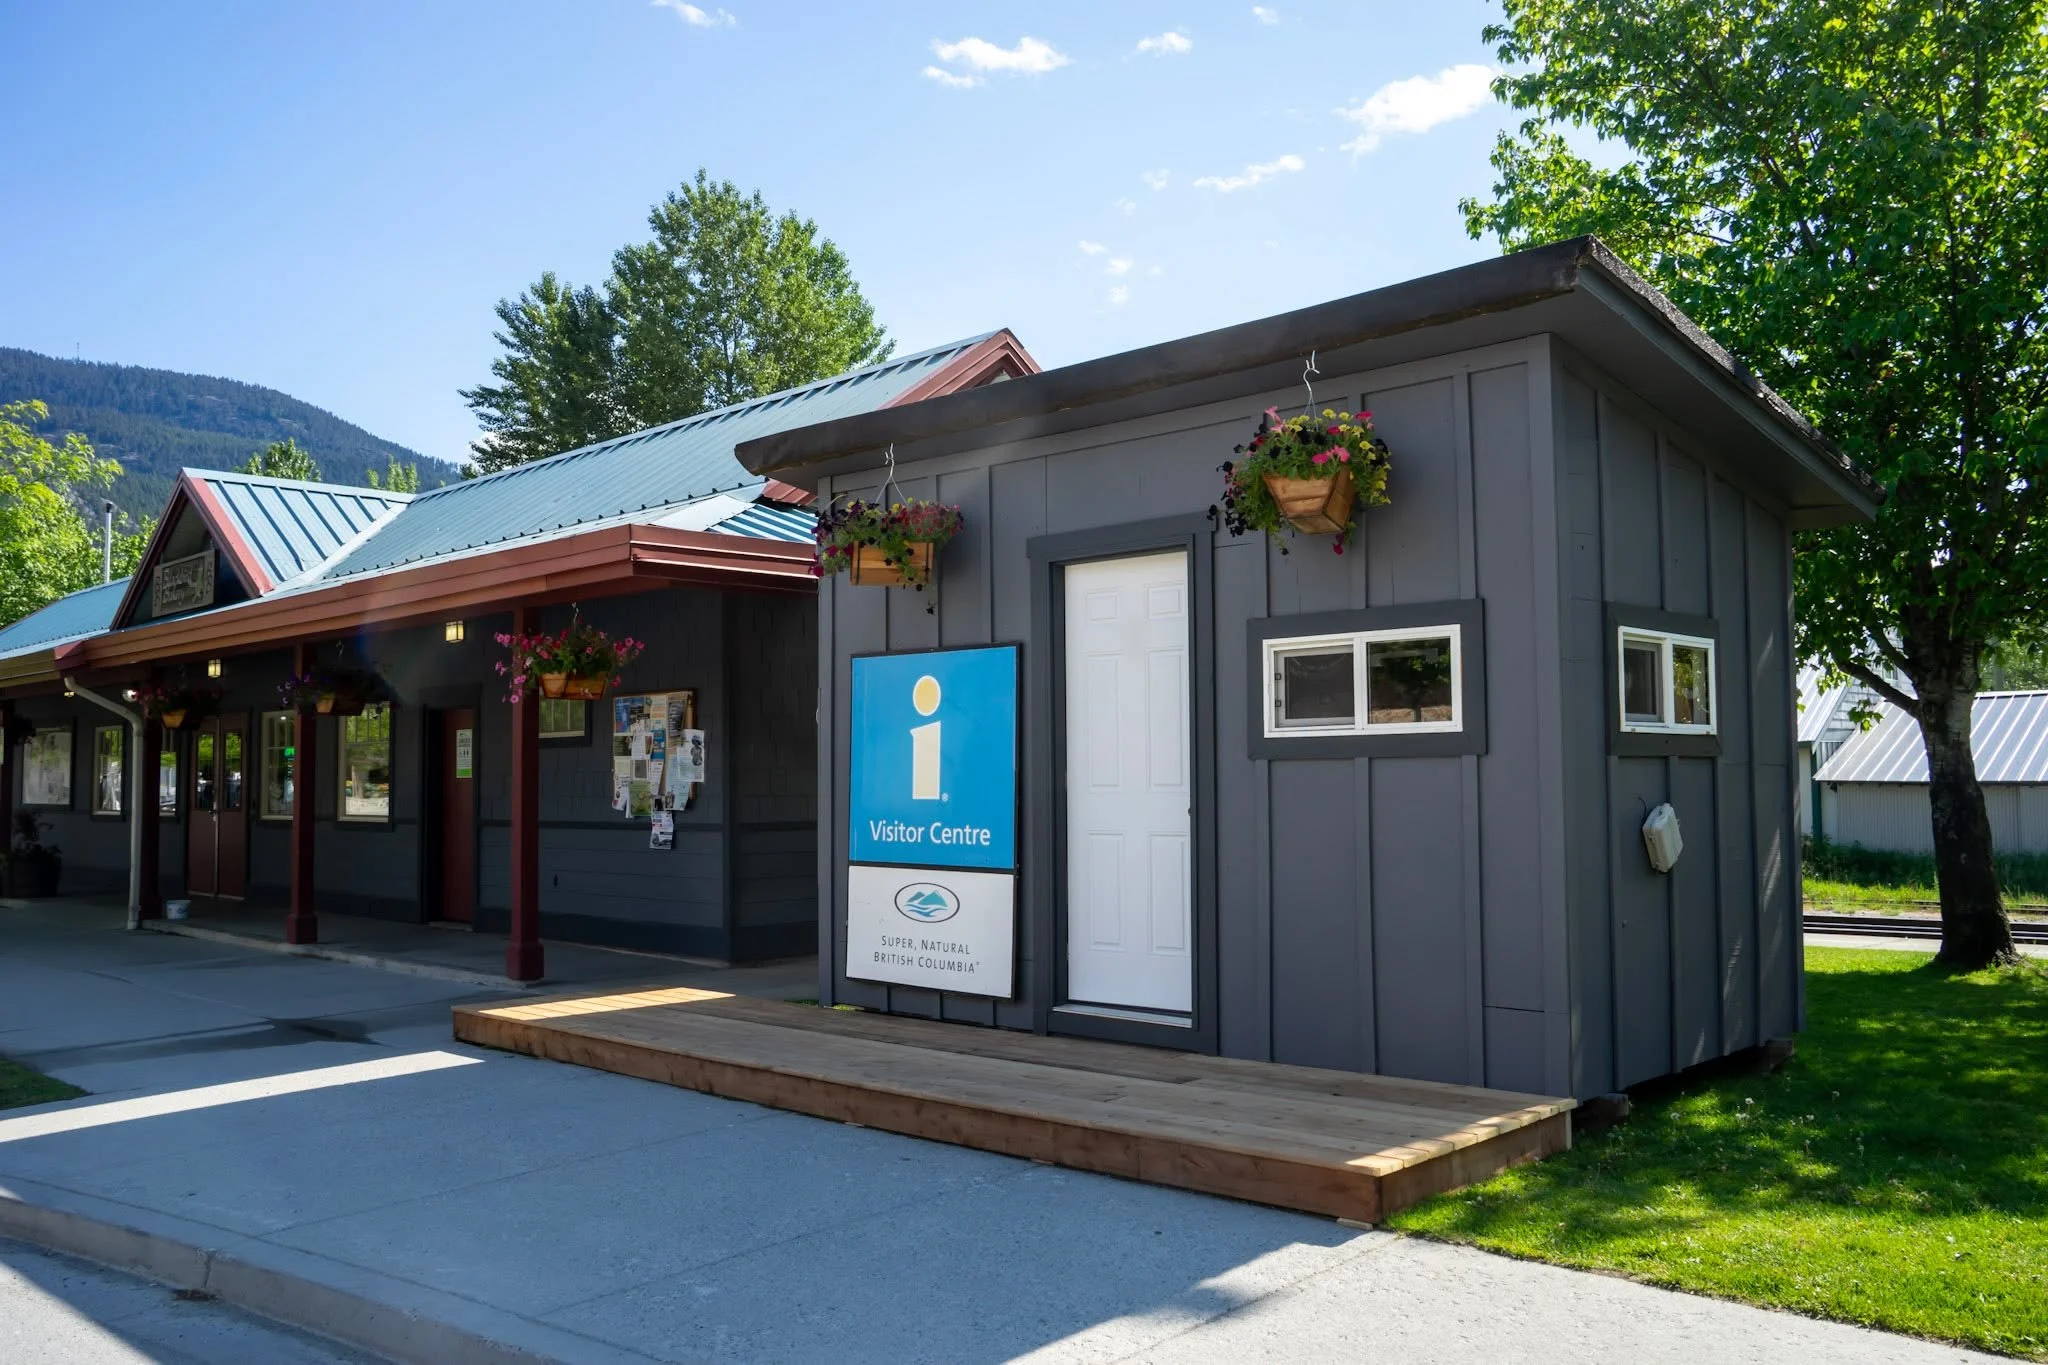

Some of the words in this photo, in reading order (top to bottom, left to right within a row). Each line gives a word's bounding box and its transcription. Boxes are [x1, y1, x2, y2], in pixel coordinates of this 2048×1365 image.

[869, 819, 925, 843] Visitor
[930, 822, 991, 846] Centre
[881, 935, 917, 951] SUPER,
[921, 939, 970, 955] NATURAL
[874, 951, 913, 966] BRITISH
